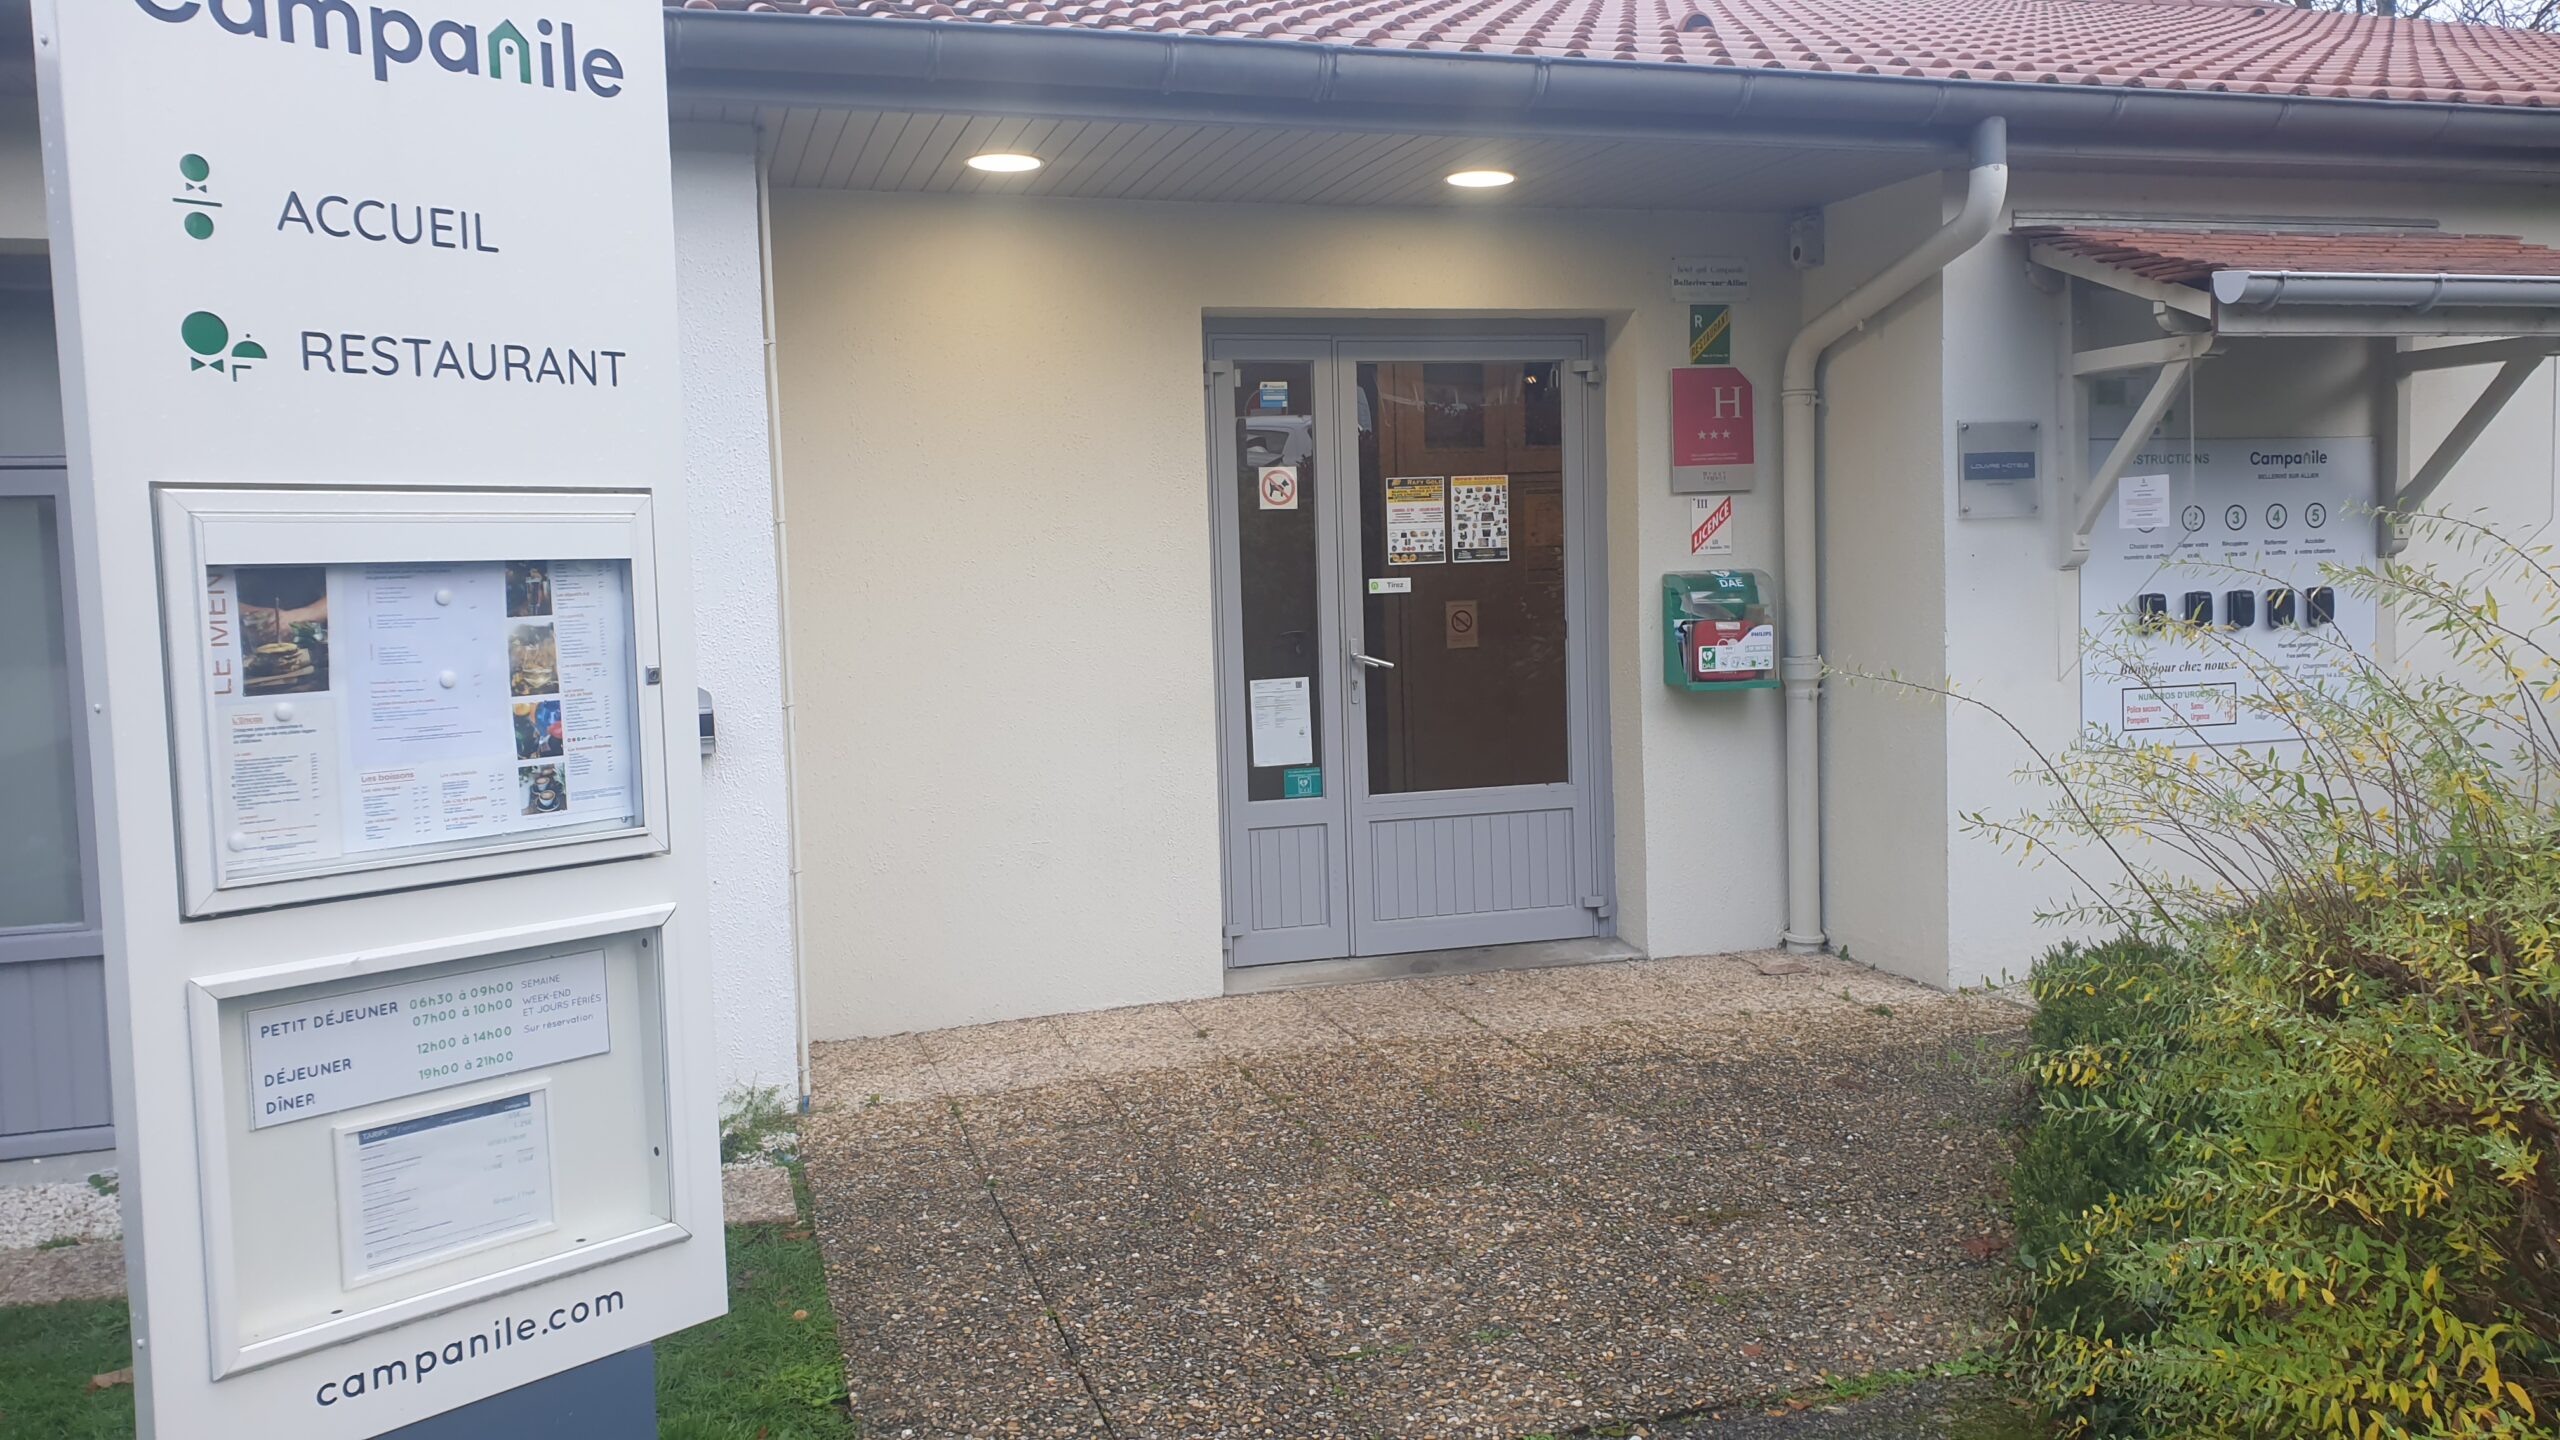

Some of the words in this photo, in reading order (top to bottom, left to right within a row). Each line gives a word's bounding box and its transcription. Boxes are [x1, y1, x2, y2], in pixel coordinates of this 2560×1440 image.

[277, 190, 500, 253] ACCUEIL
[1694, 314, 1703, 328] R
[1691, 309, 1729, 358] RESTAURANT
[301, 331, 626, 387] RESTAURANT
[1712, 386, 1743, 418] H
[2133, 453, 2210, 465] STRUCTIONS
[2250, 449, 2328, 469] Campanile
[1696, 498, 1708, 508] III
[1694, 500, 1729, 549] LICENCE
[2232, 511, 2240, 525] 3
[2272, 509, 2281, 523] 4
[2311, 508, 2321, 522] 5
[1719, 579, 1744, 587] DAE
[207, 573, 229, 647] MEN
[213, 658, 232, 696] LE
[2179, 660, 2202, 672] chez
[379, 771, 415, 782] boissons
[521, 974, 560, 989] SEMAINE
[410, 993, 452, 1010] 06h30
[459, 990, 466, 1000] à
[470, 981, 513, 998] 09h00
[522, 989, 571, 1005] WEEK-END
[523, 1007, 534, 1016] ET
[538, 1000, 568, 1014] JOURS
[572, 993, 601, 1007] FÉRIÉS
[260, 1018, 307, 1038] PETIT
[314, 1002, 398, 1028] DÉJEUNER
[413, 1009, 456, 1027] 07h00
[462, 1006, 469, 1017] à
[474, 998, 513, 1014] 10h00
[523, 1025, 539, 1034] Sur
[543, 1014, 594, 1029] réservation
[417, 1037, 456, 1054] 12h00
[462, 1035, 470, 1045] à
[474, 1026, 512, 1043] 14h00
[264, 1058, 352, 1087] DÉJEUNER
[419, 1062, 459, 1080] 19h00
[464, 1060, 472, 1070] à
[476, 1051, 513, 1068] 21h00
[266, 1092, 316, 1115] DÎNER
[316, 1290, 624, 1406] campanile.com
